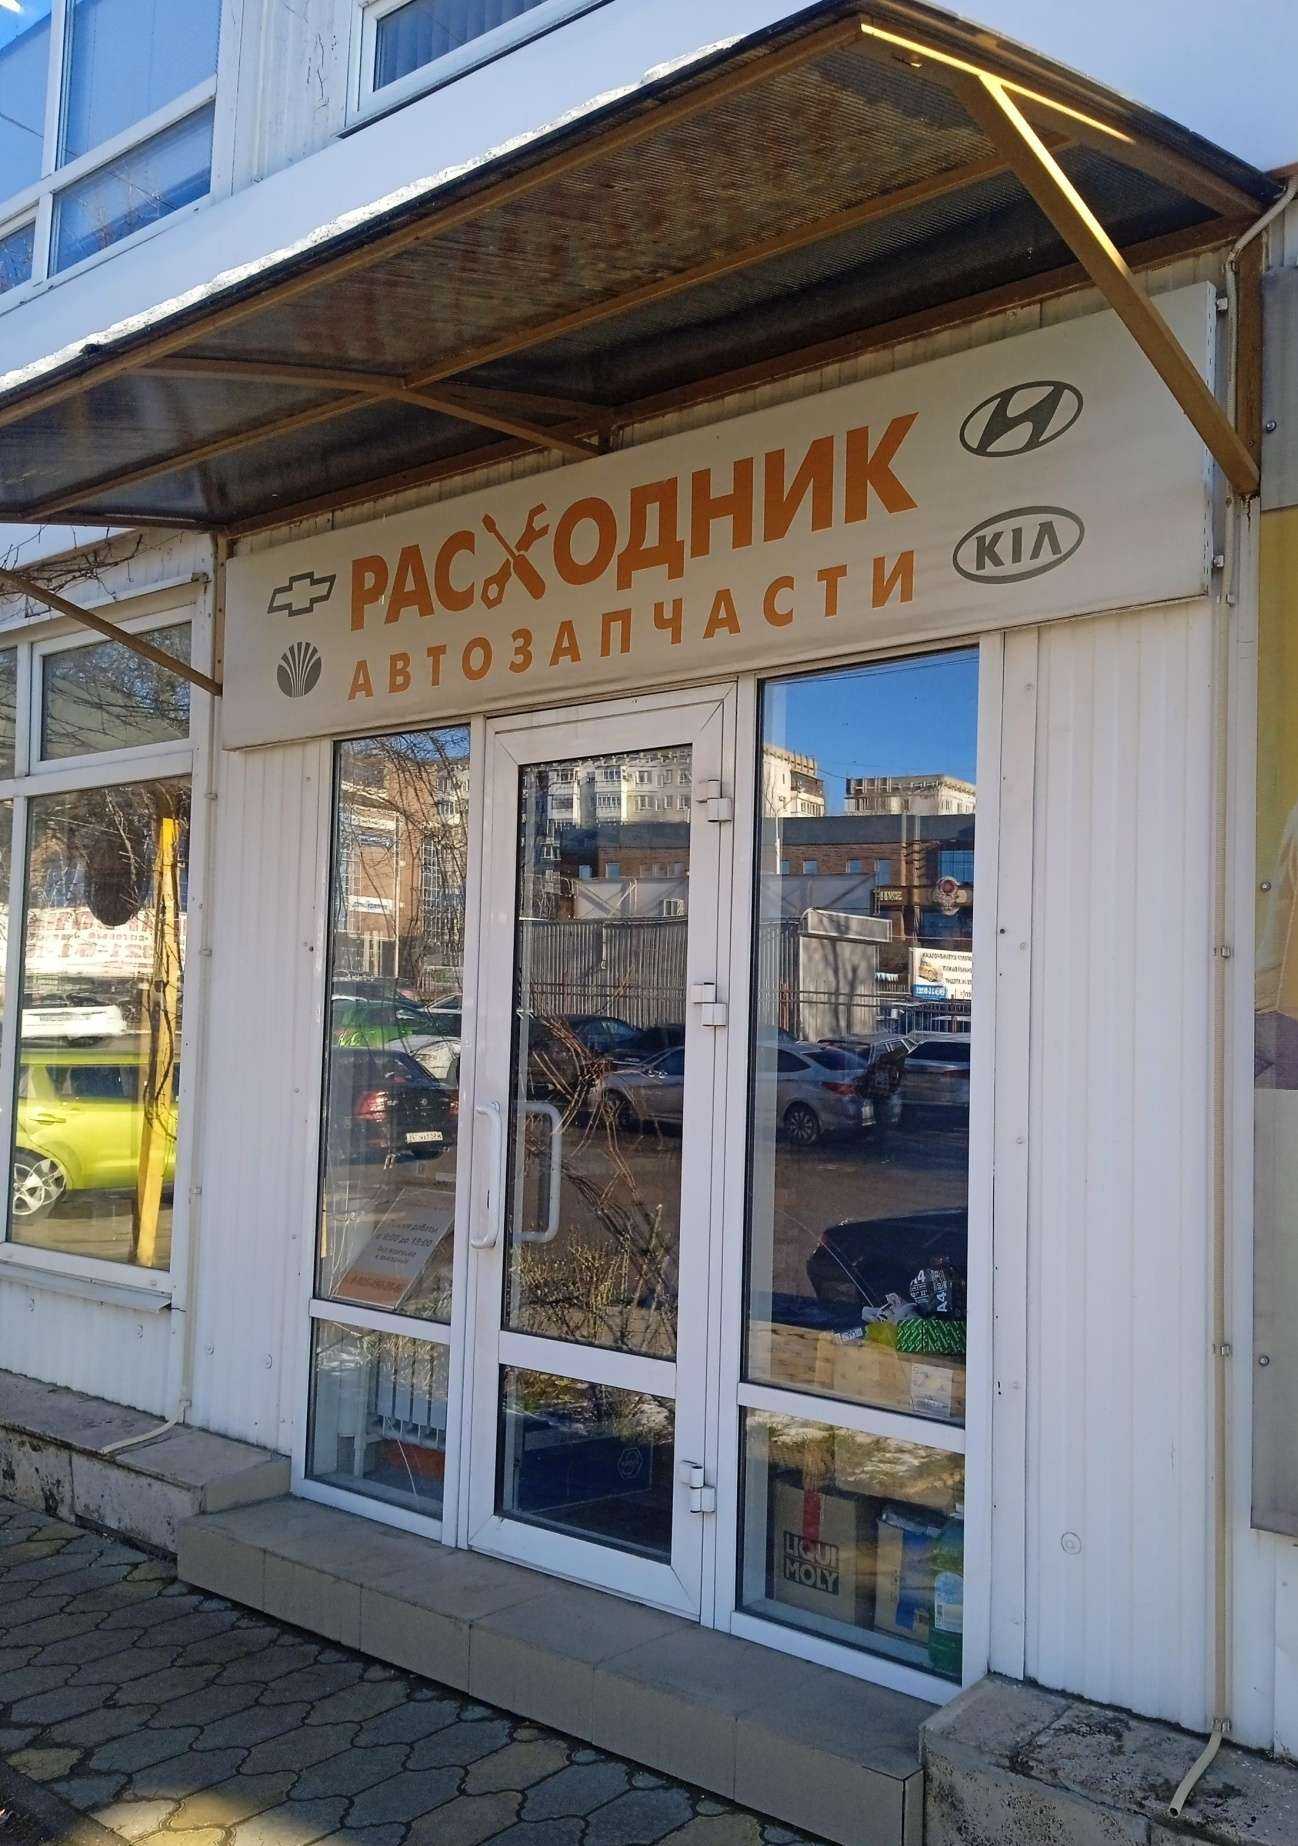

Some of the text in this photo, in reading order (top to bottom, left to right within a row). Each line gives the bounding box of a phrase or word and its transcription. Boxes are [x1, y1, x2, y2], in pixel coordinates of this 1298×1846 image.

[351, 412, 919, 632] РАСХОДНИК
[975, 520, 1062, 571] KIA
[347, 550, 915, 700] АВТОЗАПЧАСТИ
[784, 1557, 839, 1592] MOLY
